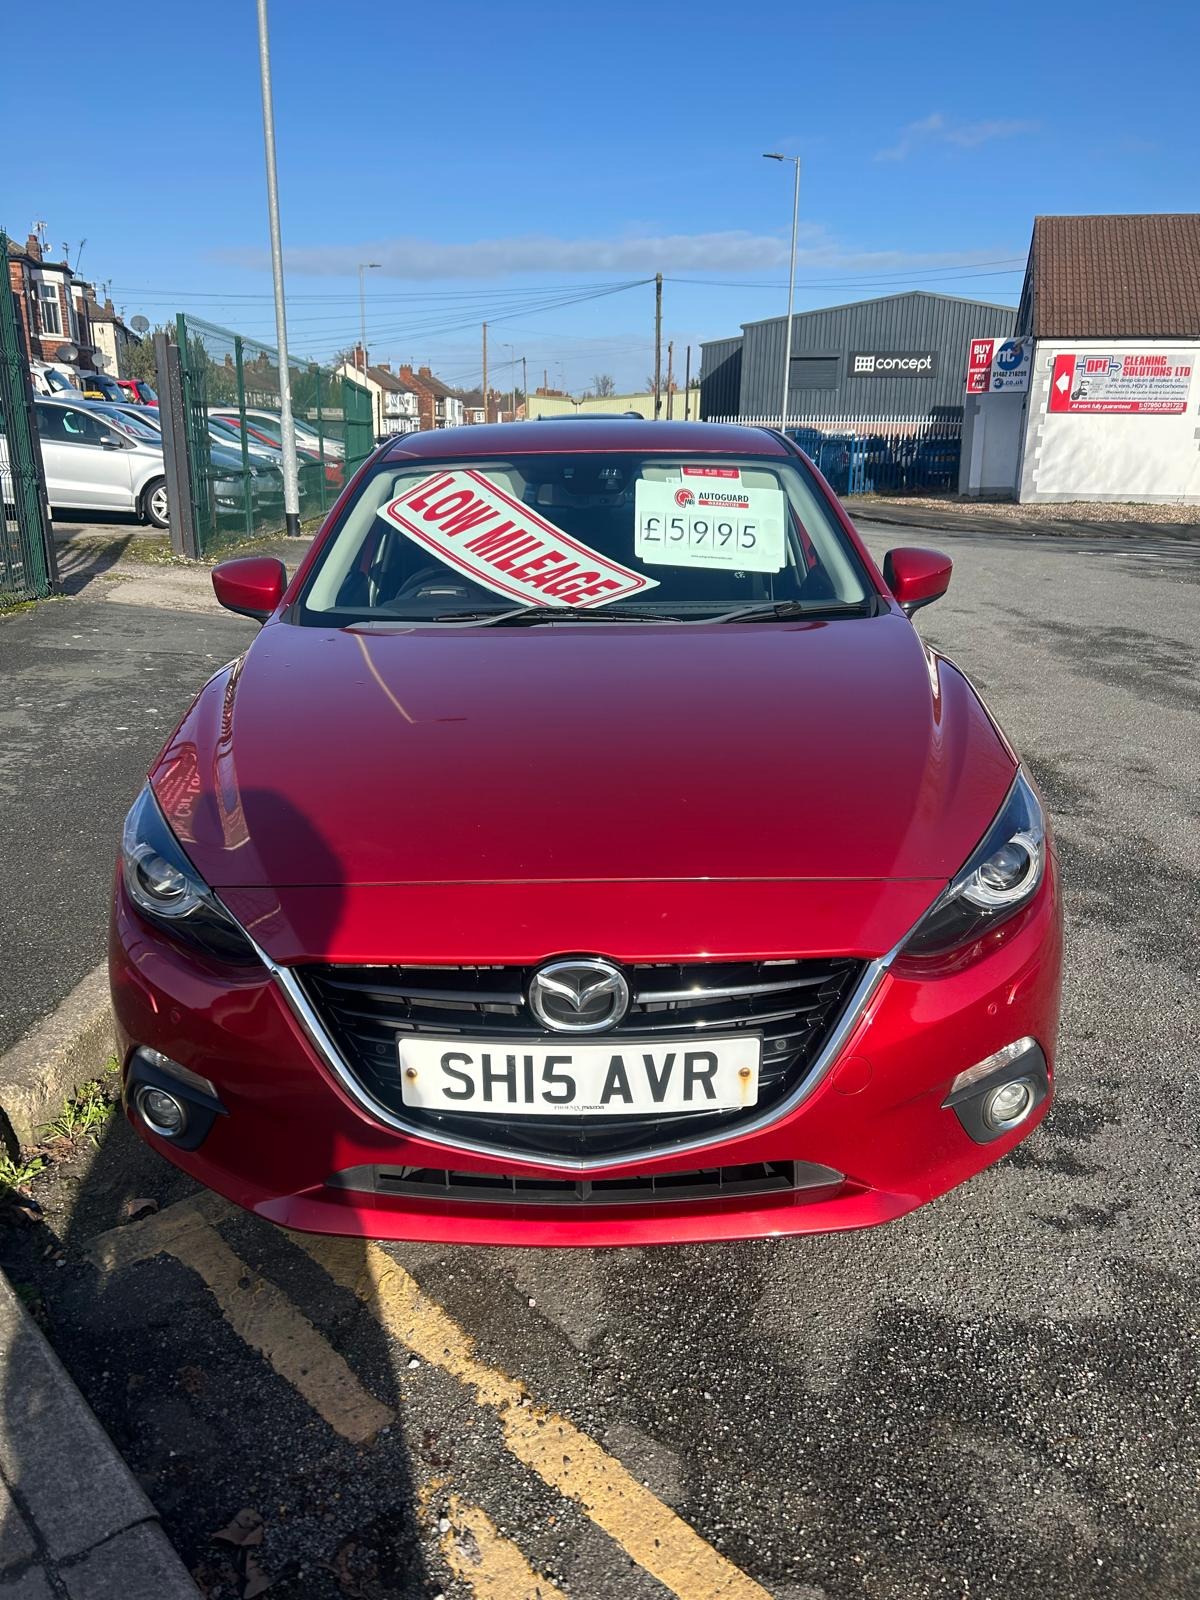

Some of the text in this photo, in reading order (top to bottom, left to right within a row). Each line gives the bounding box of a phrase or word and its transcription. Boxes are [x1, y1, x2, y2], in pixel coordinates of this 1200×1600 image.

[974, 344, 991, 354] BUY
[876, 355, 932, 373] concept
[976, 354, 987, 364] IT!
[1124, 356, 1167, 366] CLEANING
[1087, 360, 1109, 373] DPF
[1122, 366, 1191, 377] SOLUTIONS LTD
[974, 373, 985, 381] FOR
[698, 492, 749, 503] AUTOGUARD
[407, 476, 500, 538] LOW
[644, 518, 757, 549] £5995
[463, 520, 623, 605] MILEAGE
[440, 1051, 720, 1105] SH15 AVR
